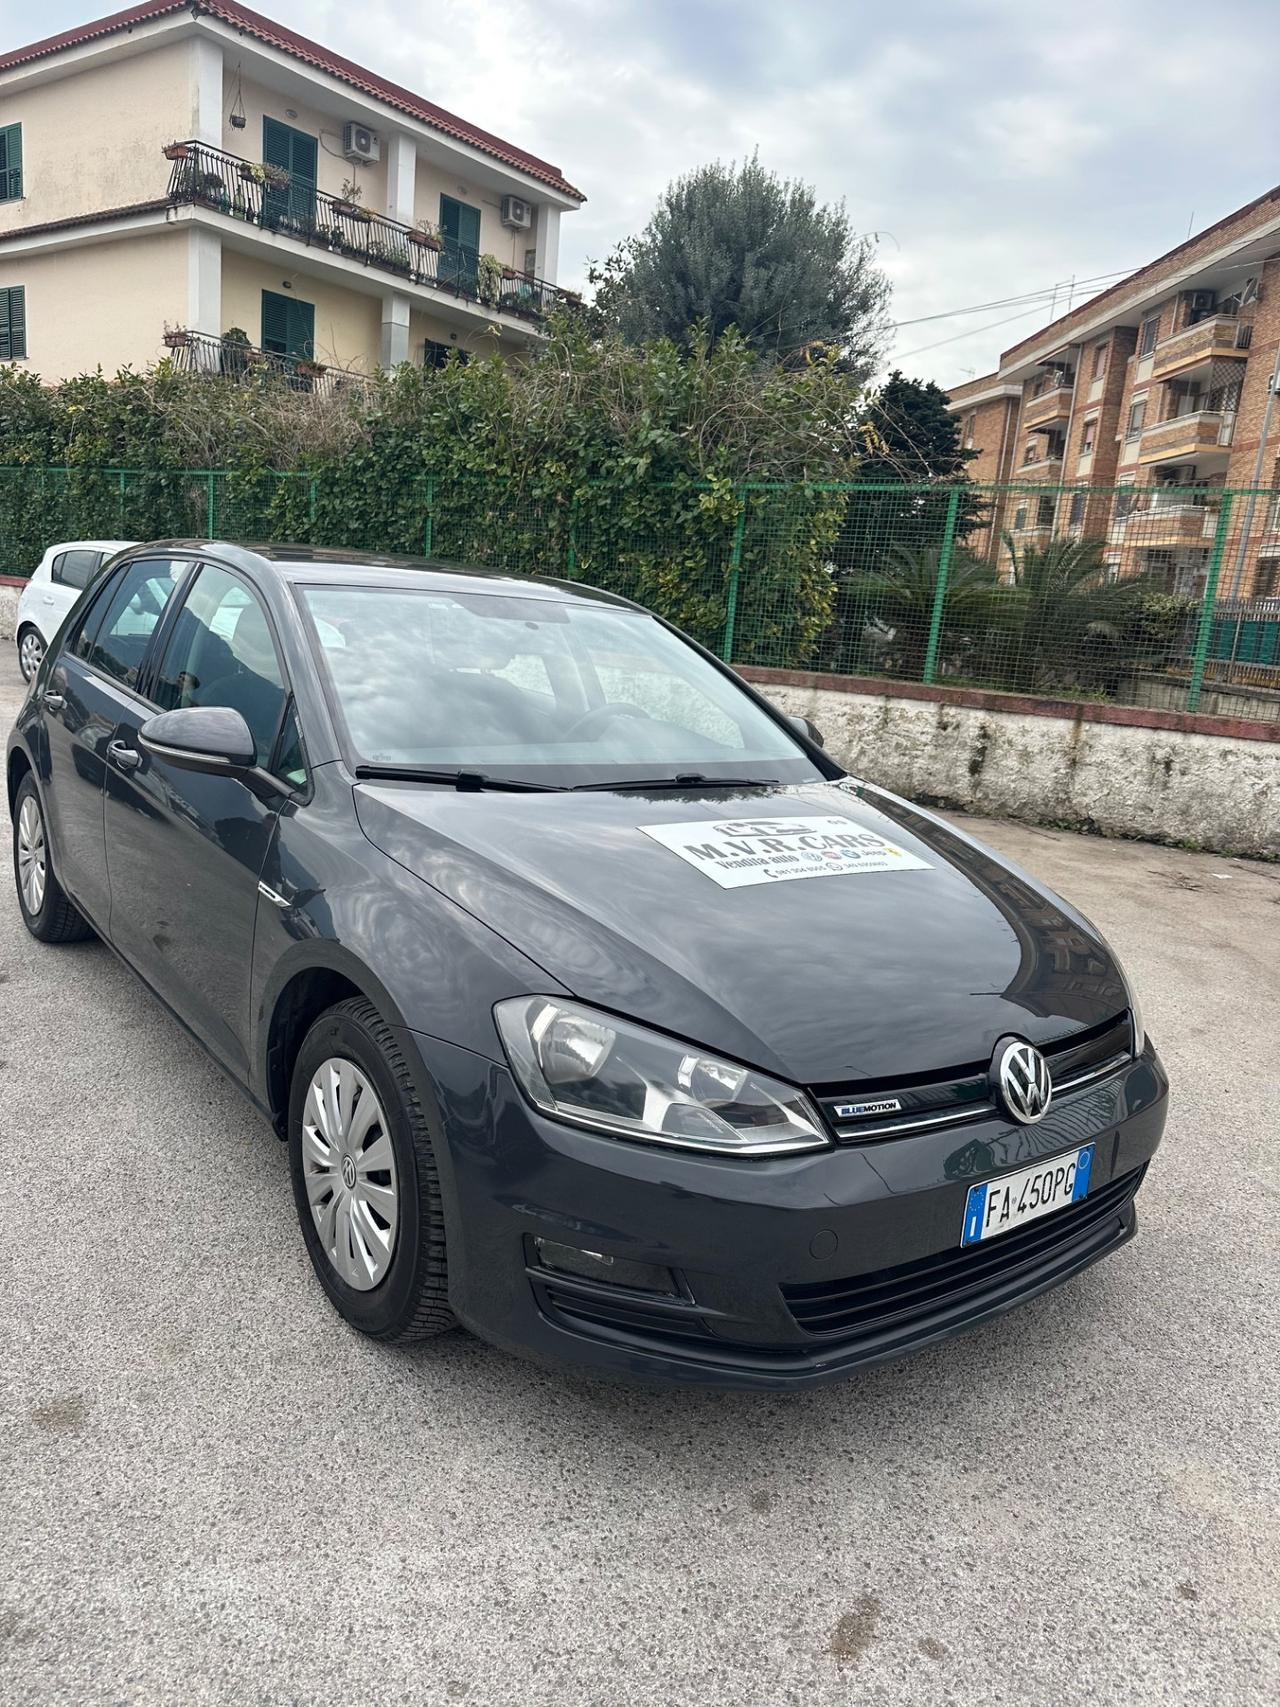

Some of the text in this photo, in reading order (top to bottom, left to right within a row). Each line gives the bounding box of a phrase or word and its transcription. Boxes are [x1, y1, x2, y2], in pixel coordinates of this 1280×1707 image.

[716, 858, 769, 869] Vendita
[768, 854, 800, 865] auto
[841, 1102, 897, 1115] BLUEMOTION
